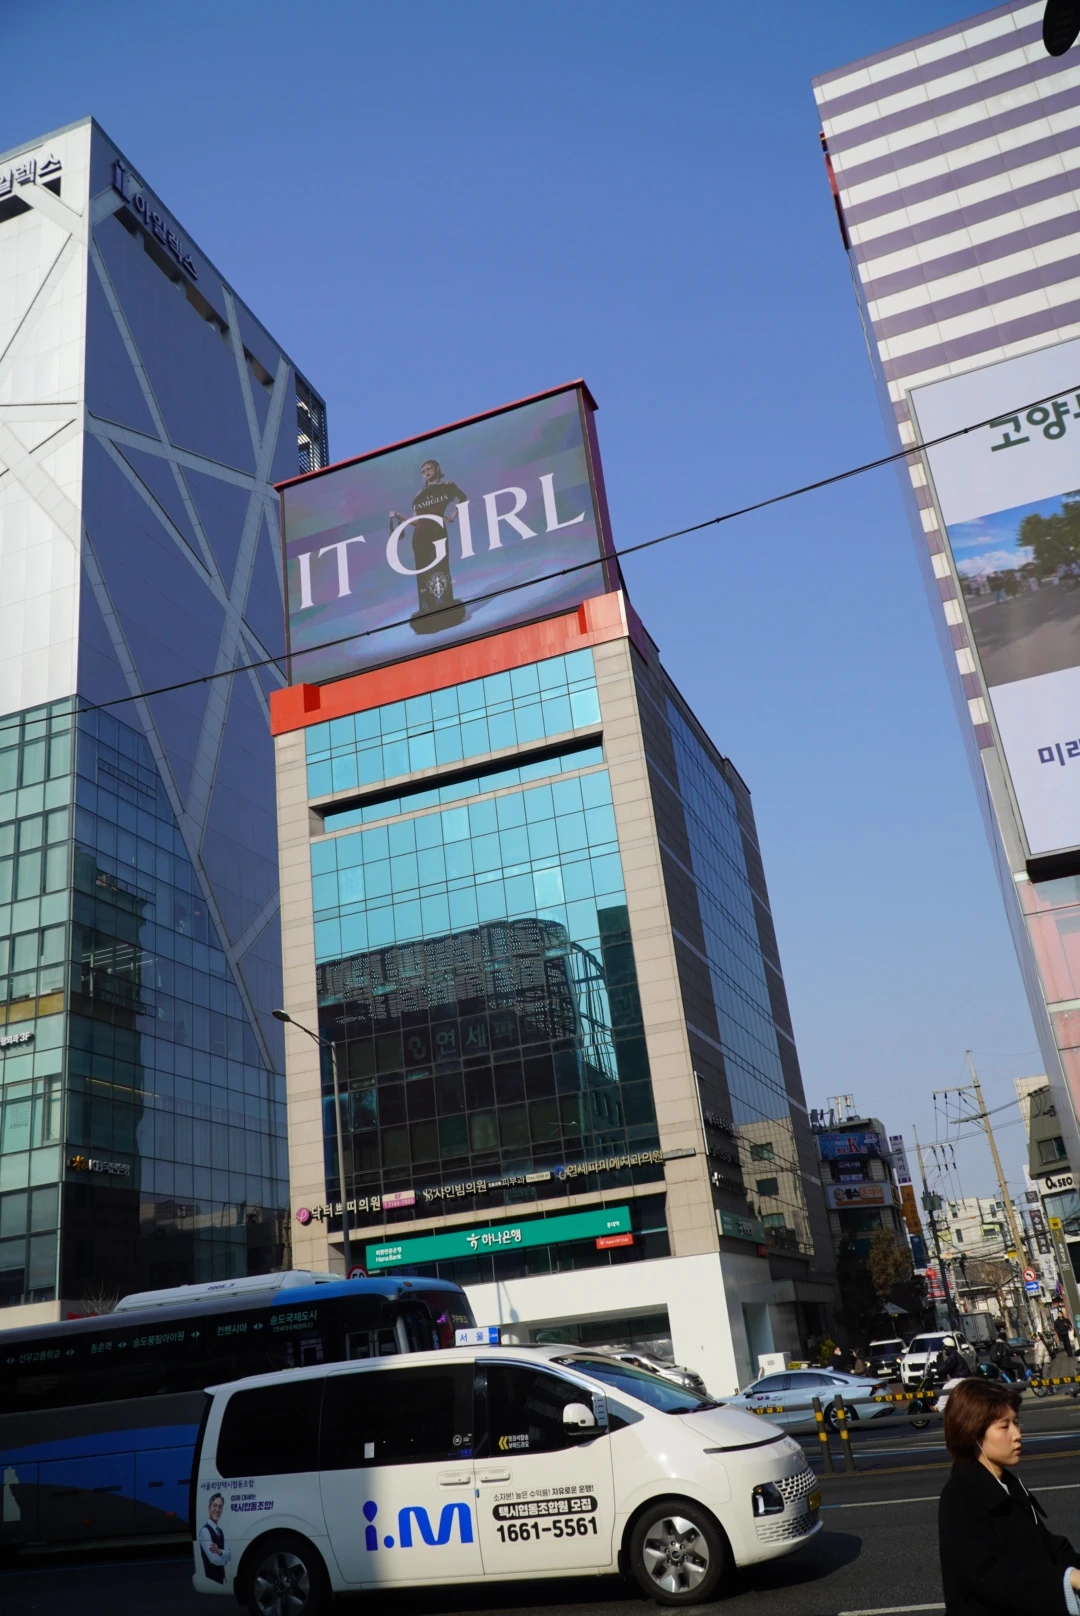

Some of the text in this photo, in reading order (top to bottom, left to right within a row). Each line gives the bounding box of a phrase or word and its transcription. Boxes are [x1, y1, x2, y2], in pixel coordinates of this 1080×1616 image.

[134, 193, 198, 280] 아일렉스
[989, 393, 1080, 452] 고양
[413, 494, 449, 510] FAMIGLIA
[297, 473, 585, 609] IT GIRL
[566, 1149, 664, 1178] 연세파미에치과의원
[434, 1180, 487, 1200] 샤인빔의원
[502, 1174, 525, 1187] 피부과
[481, 1228, 522, 1246] 하나은행
[216, 1322, 247, 1336] 컨벤시아
[269, 1309, 318, 1326] 송도국제도시
[459, 1331, 484, 1342] 서울
[493, 1484, 594, 1502] 소자본! 높은 수익률! 자유로운 운행!
[498, 1497, 592, 1518] 택시협동조합원 모집
[496, 1516, 598, 1543] 1661-5561
